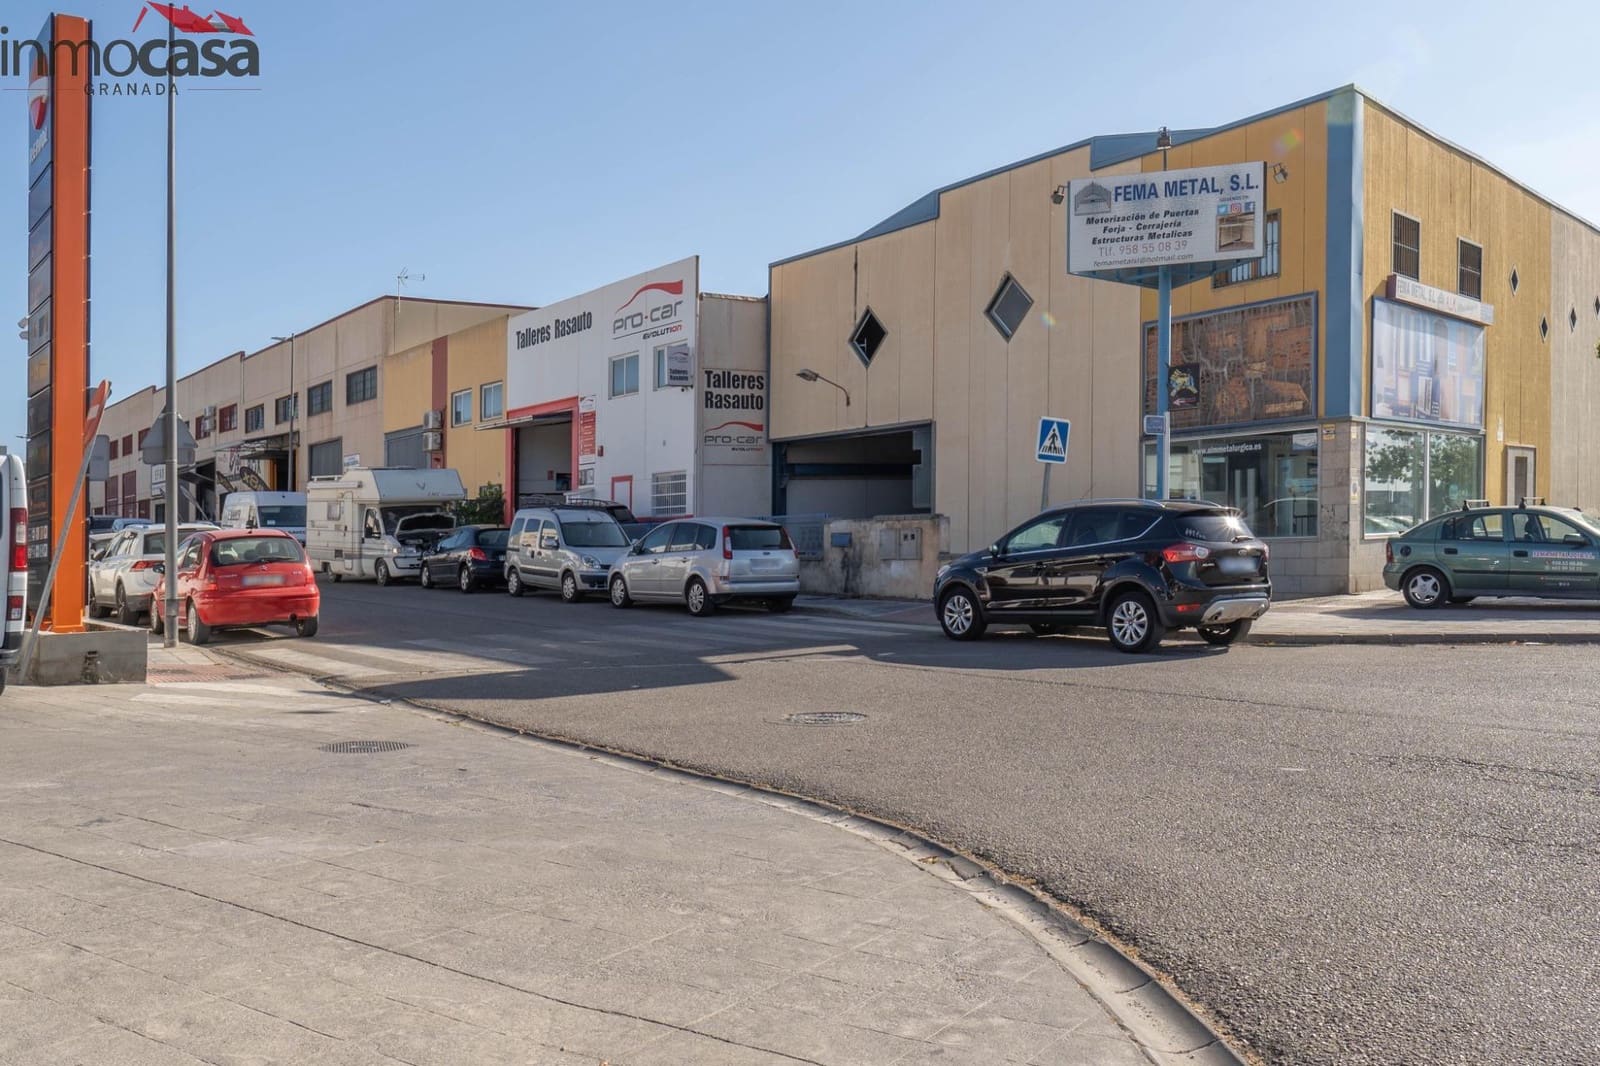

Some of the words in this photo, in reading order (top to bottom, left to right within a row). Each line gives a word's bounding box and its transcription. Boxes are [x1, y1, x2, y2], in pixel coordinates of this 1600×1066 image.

[1113, 182, 1159, 203] FEMA
[1164, 175, 1224, 198] METAL,
[1230, 172, 1259, 191] S.L.
[1086, 213, 1146, 225] Motorización
[1149, 210, 1160, 219] de
[1163, 208, 1199, 218] Puertas
[1092, 235, 1144, 245] Estructuras
[1147, 229, 1193, 240] Metalicas
[1103, 224, 1126, 234] Forja
[1119, 243, 1139, 256] 958
[1141, 242, 1155, 254] 55
[1158, 240, 1172, 252] 08
[1175, 239, 1188, 251] 39
[516, 323, 551, 350] Talleres
[554, 311, 593, 340] Rasauto
[704, 370, 765, 390] Talleres
[704, 391, 764, 410] Rasauto
